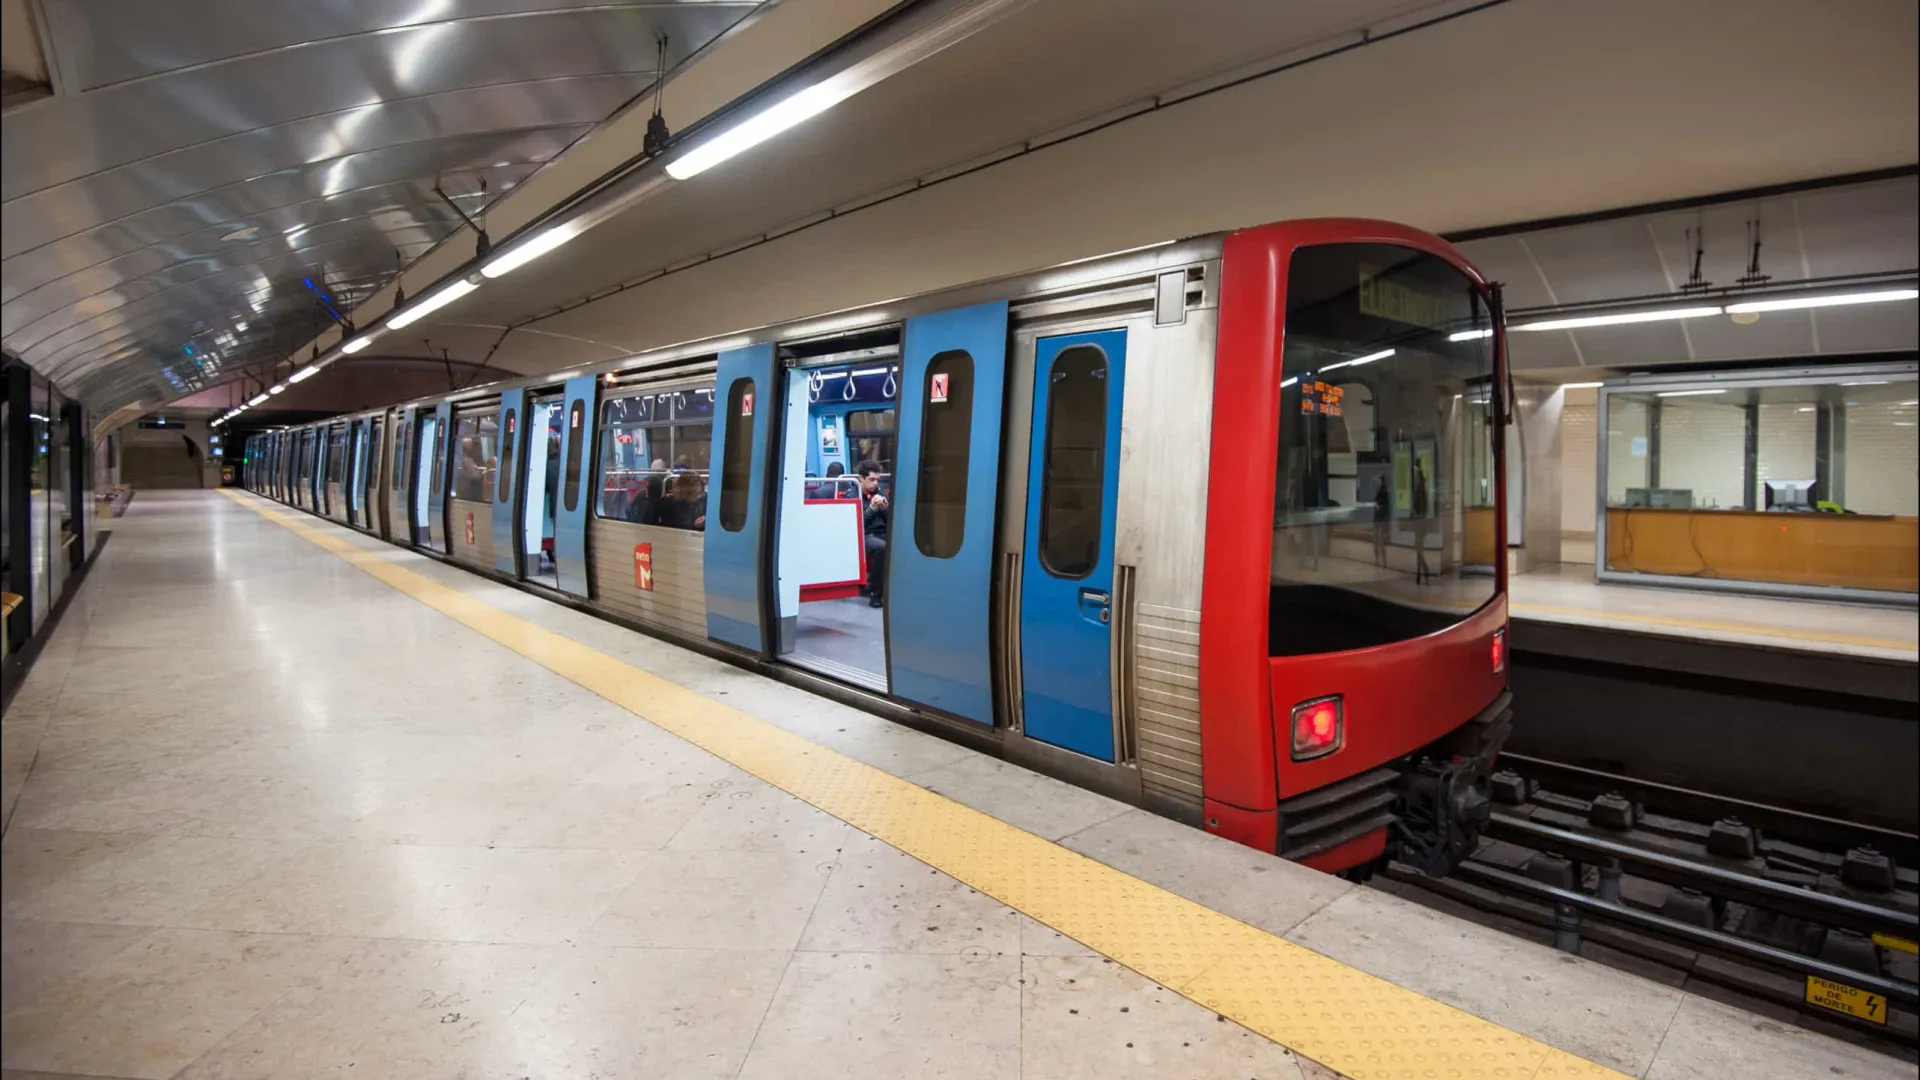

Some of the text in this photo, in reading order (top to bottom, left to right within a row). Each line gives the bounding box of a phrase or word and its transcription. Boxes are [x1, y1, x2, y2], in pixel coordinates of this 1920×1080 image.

[1813, 978, 1857, 996] PERIGO
[1826, 990, 1842, 1001] DE
[1813, 995, 1856, 1013] MORTE
